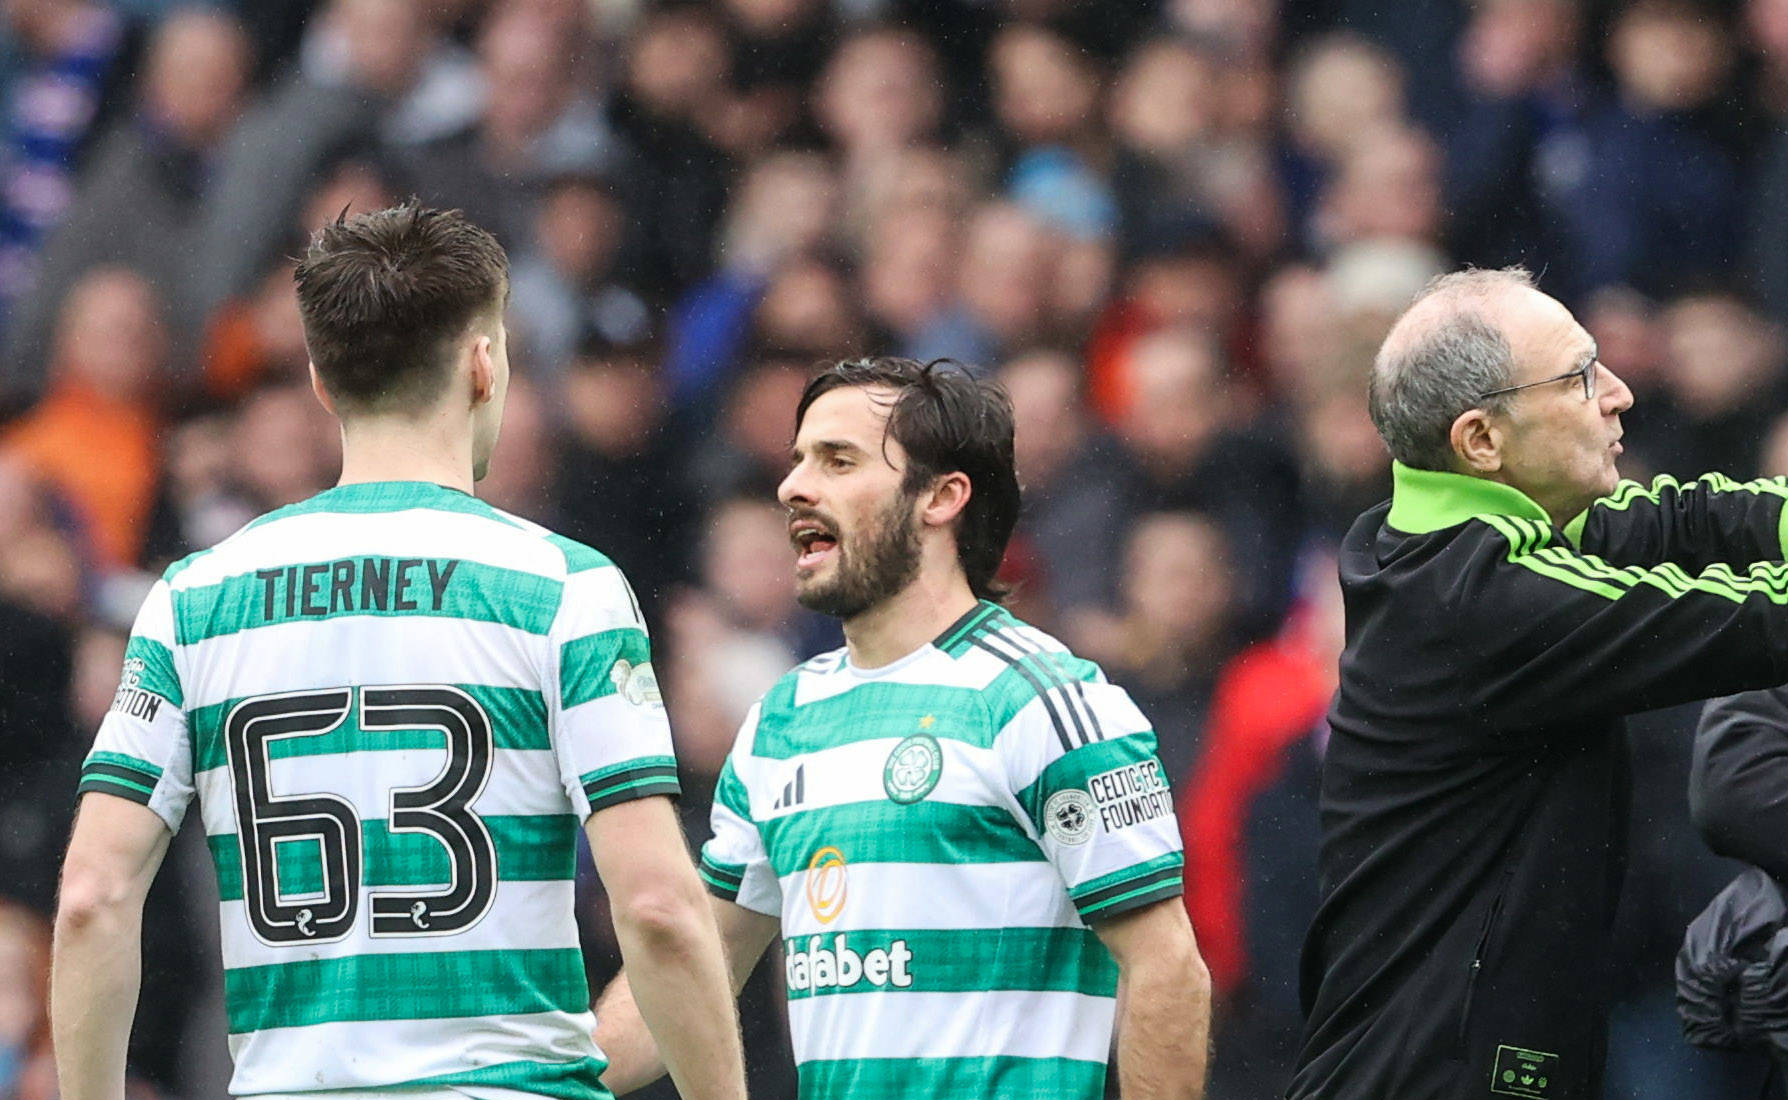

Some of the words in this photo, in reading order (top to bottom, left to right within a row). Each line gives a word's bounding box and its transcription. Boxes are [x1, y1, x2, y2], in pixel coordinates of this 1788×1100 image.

[256, 558, 460, 622] TIERNEY
[1090, 766, 1142, 804] CELTIC
[1139, 761, 1160, 790] FC
[225, 683, 499, 948] 63
